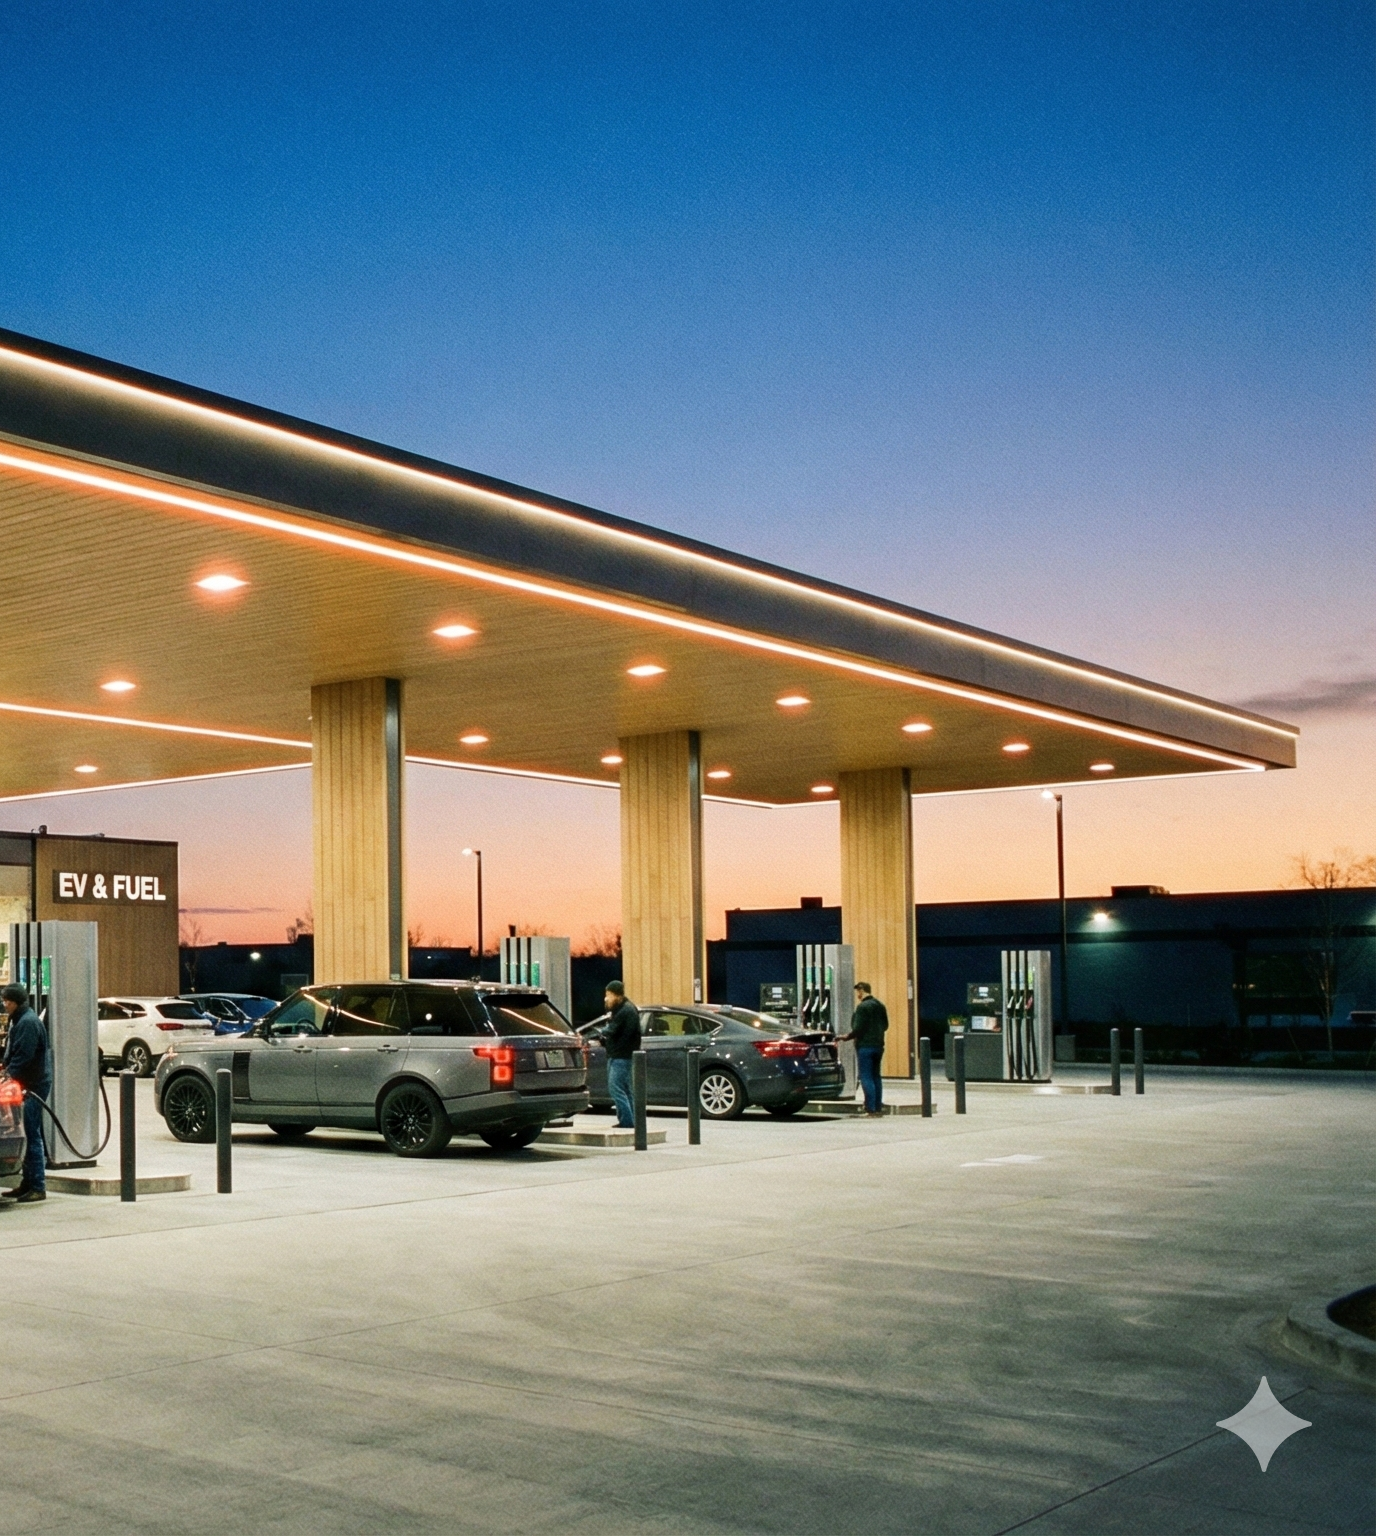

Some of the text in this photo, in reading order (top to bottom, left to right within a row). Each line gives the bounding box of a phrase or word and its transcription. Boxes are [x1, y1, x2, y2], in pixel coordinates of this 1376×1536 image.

[59, 872, 166, 901] EV & FUEL
